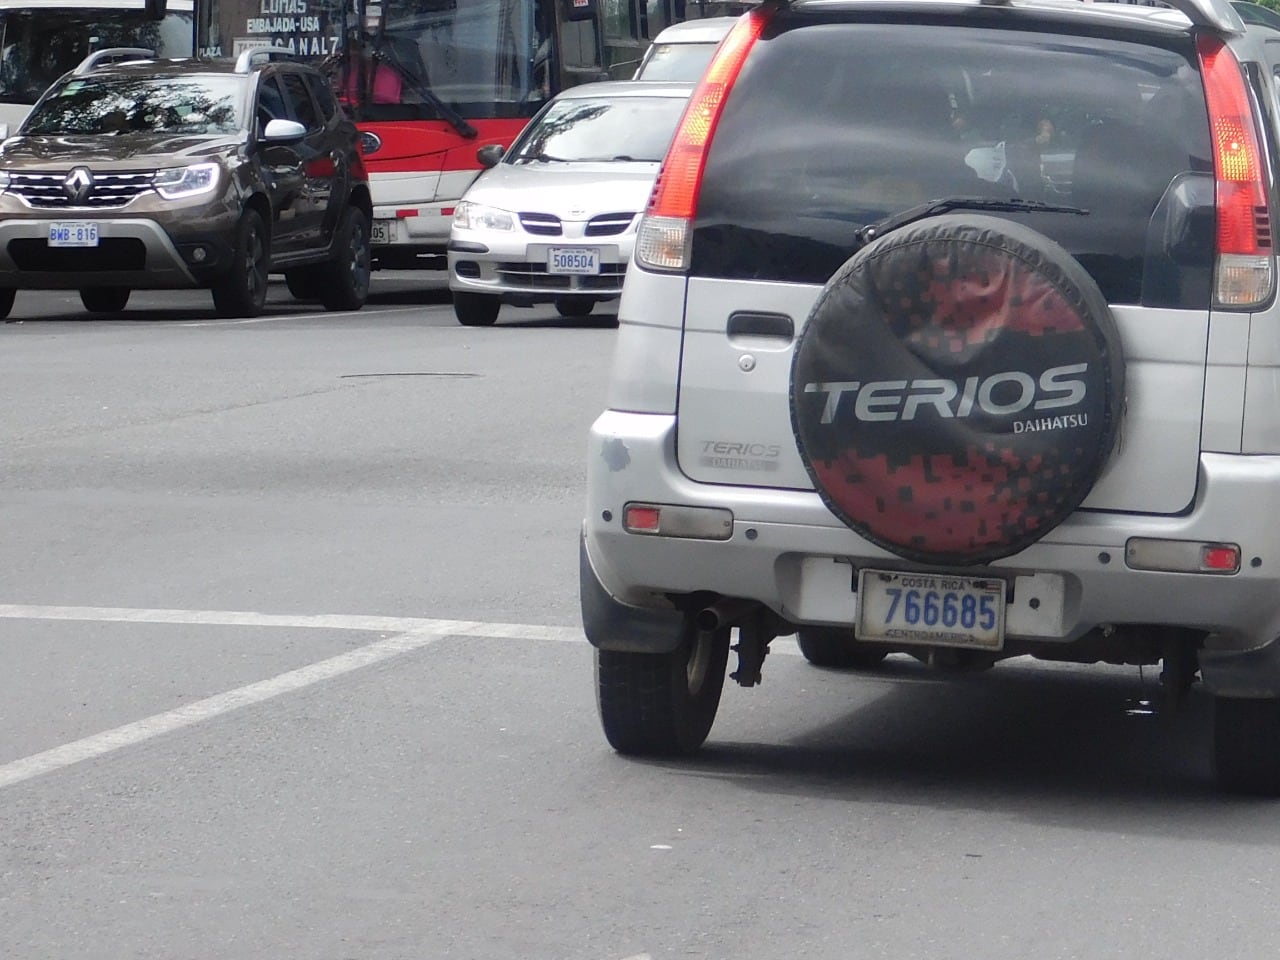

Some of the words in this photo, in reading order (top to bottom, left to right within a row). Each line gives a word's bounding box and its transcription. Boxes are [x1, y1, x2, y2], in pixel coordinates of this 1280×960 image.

[50, 228, 96, 241] BWB-816
[553, 254, 594, 268] 508504
[804, 362, 1088, 425] TERIOS
[1013, 413, 1088, 435] DAIHATSU
[703, 440, 781, 457] TERIOS
[902, 577, 937, 588] COSTA
[941, 580, 966, 591] RICA
[885, 588, 996, 631] 766685
